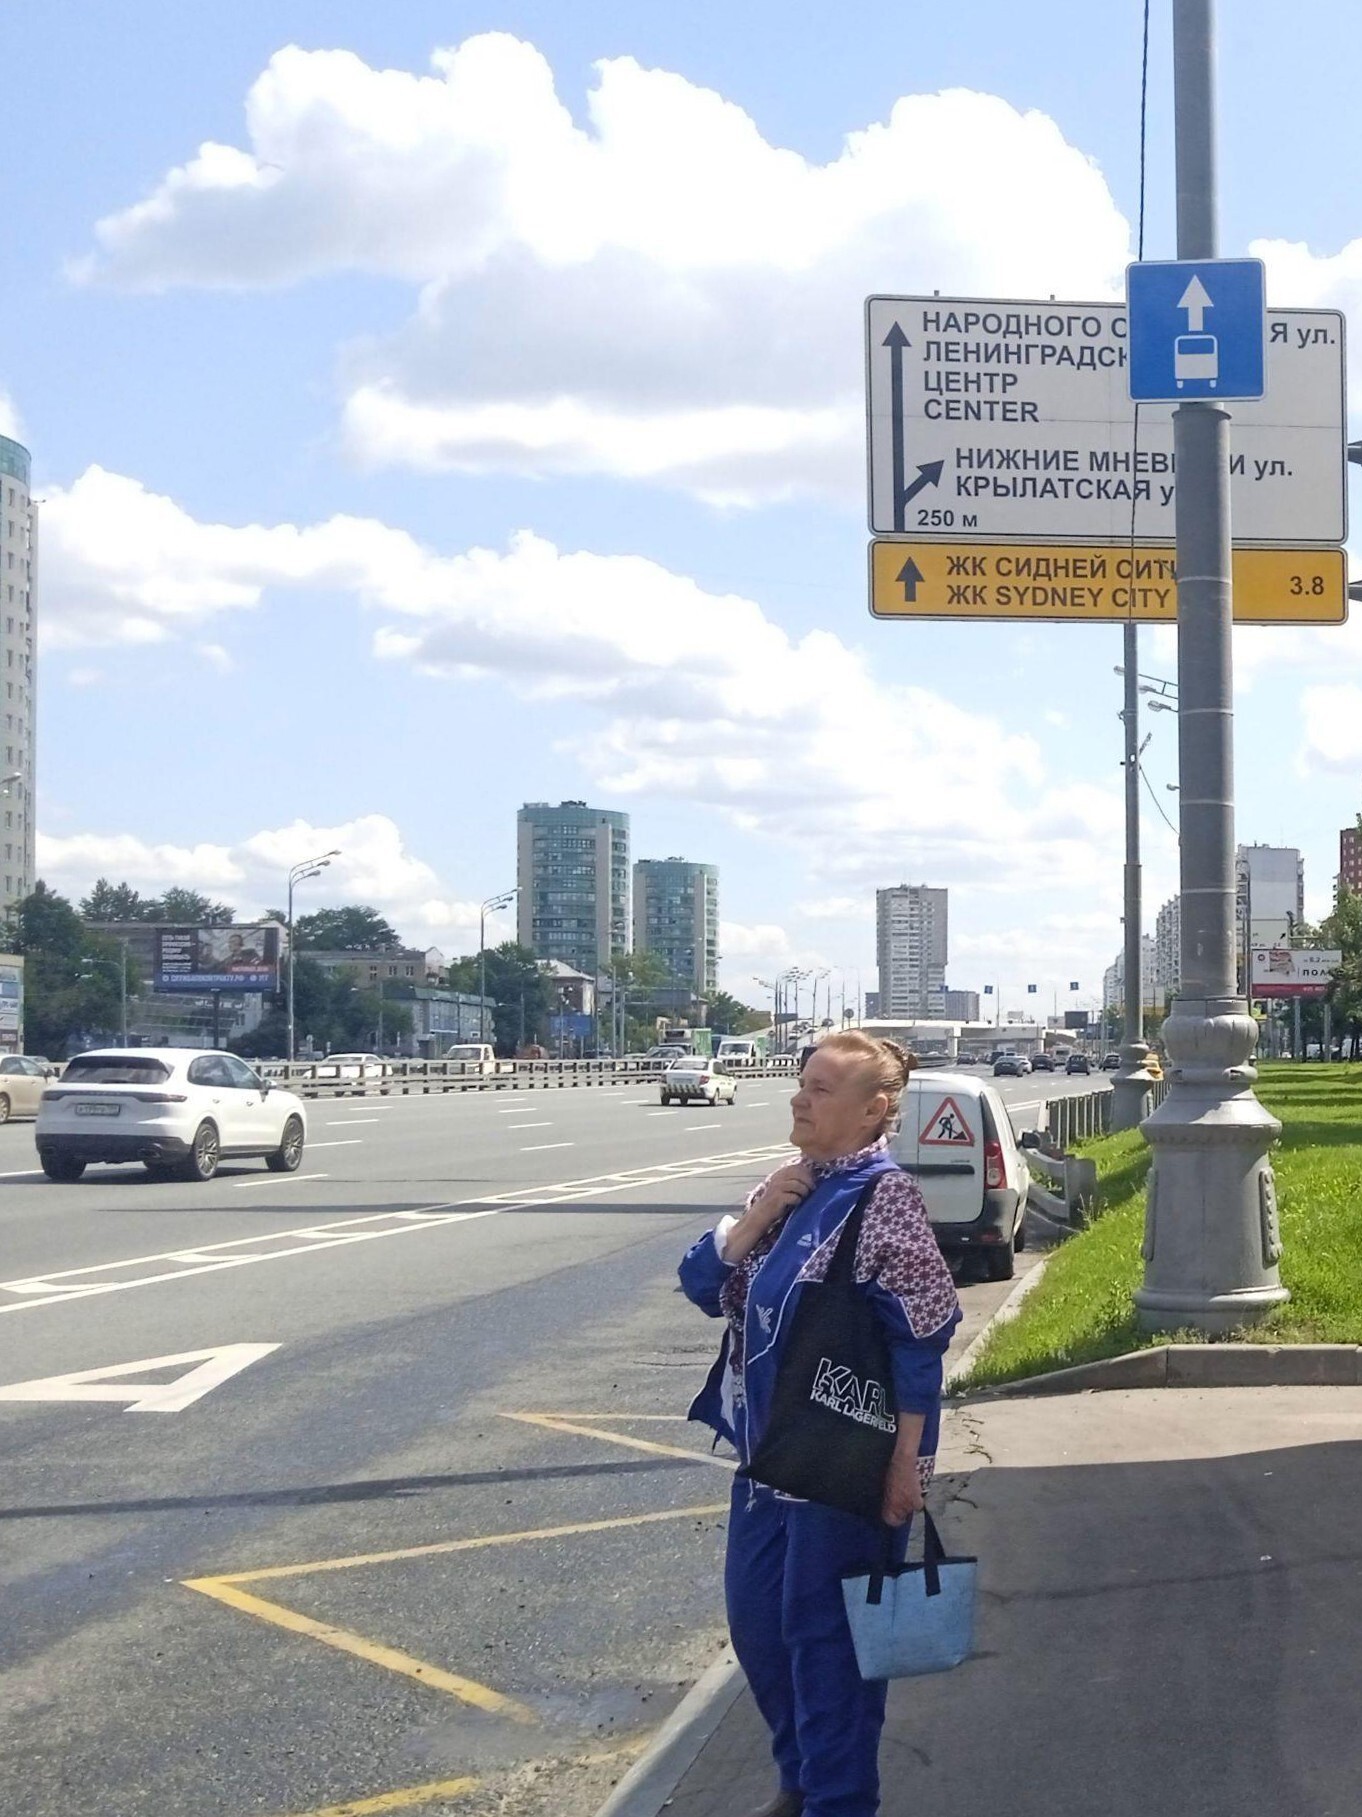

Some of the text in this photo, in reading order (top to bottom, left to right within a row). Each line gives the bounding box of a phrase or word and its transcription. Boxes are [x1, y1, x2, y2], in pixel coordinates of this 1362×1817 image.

[923, 311, 1101, 339] НАРОДНОГО
[1297, 328, 1335, 348] ул.
[924, 371, 1018, 396] ЦЕНТР
[924, 399, 1040, 422] CENTER
[956, 448, 1080, 471] НИЖНИЕ
[1254, 458, 1293, 481] ул.
[956, 476, 1150, 500] КРЫЛАТСКАЯ
[917, 508, 978, 527] 250 м
[947, 554, 1176, 581] ЖК СИДНЕЙ СИТ
[947, 585, 1170, 608] ЖК SYDNEY CITY
[1290, 575, 1324, 596] 3.8
[813, 1357, 895, 1423] KARL
[810, 1389, 897, 1434] KARL LAGERFELD
